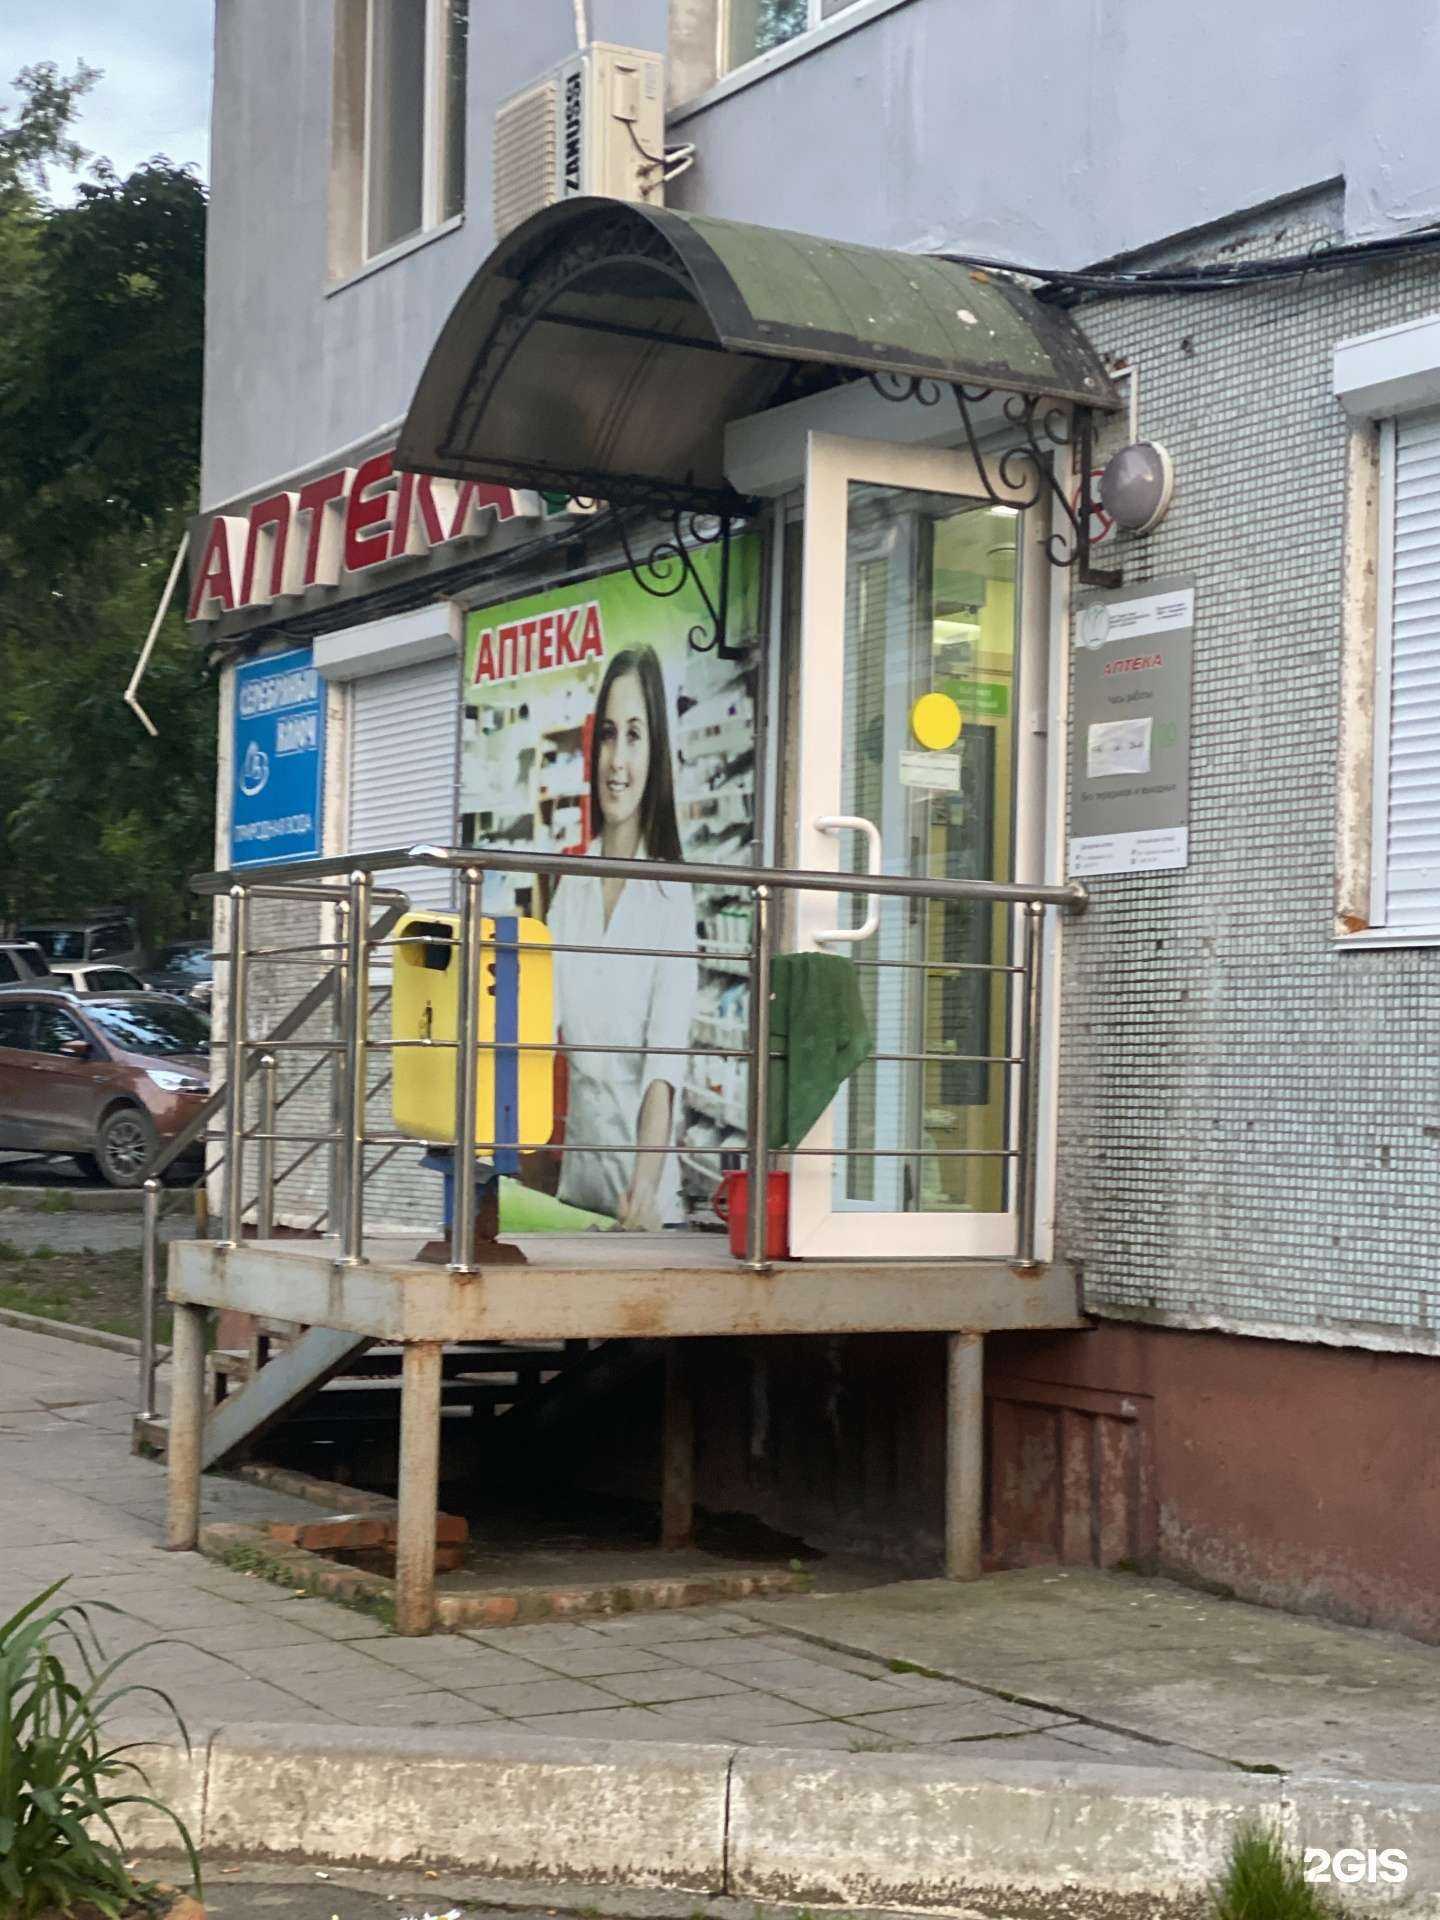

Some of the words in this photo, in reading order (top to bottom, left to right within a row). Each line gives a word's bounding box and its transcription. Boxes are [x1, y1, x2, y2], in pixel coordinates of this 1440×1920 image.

[565, 72, 581, 196] ZANUSSI
[474, 604, 604, 685] АПТЕКА
[1103, 654, 1163, 675] АПТЕКА
